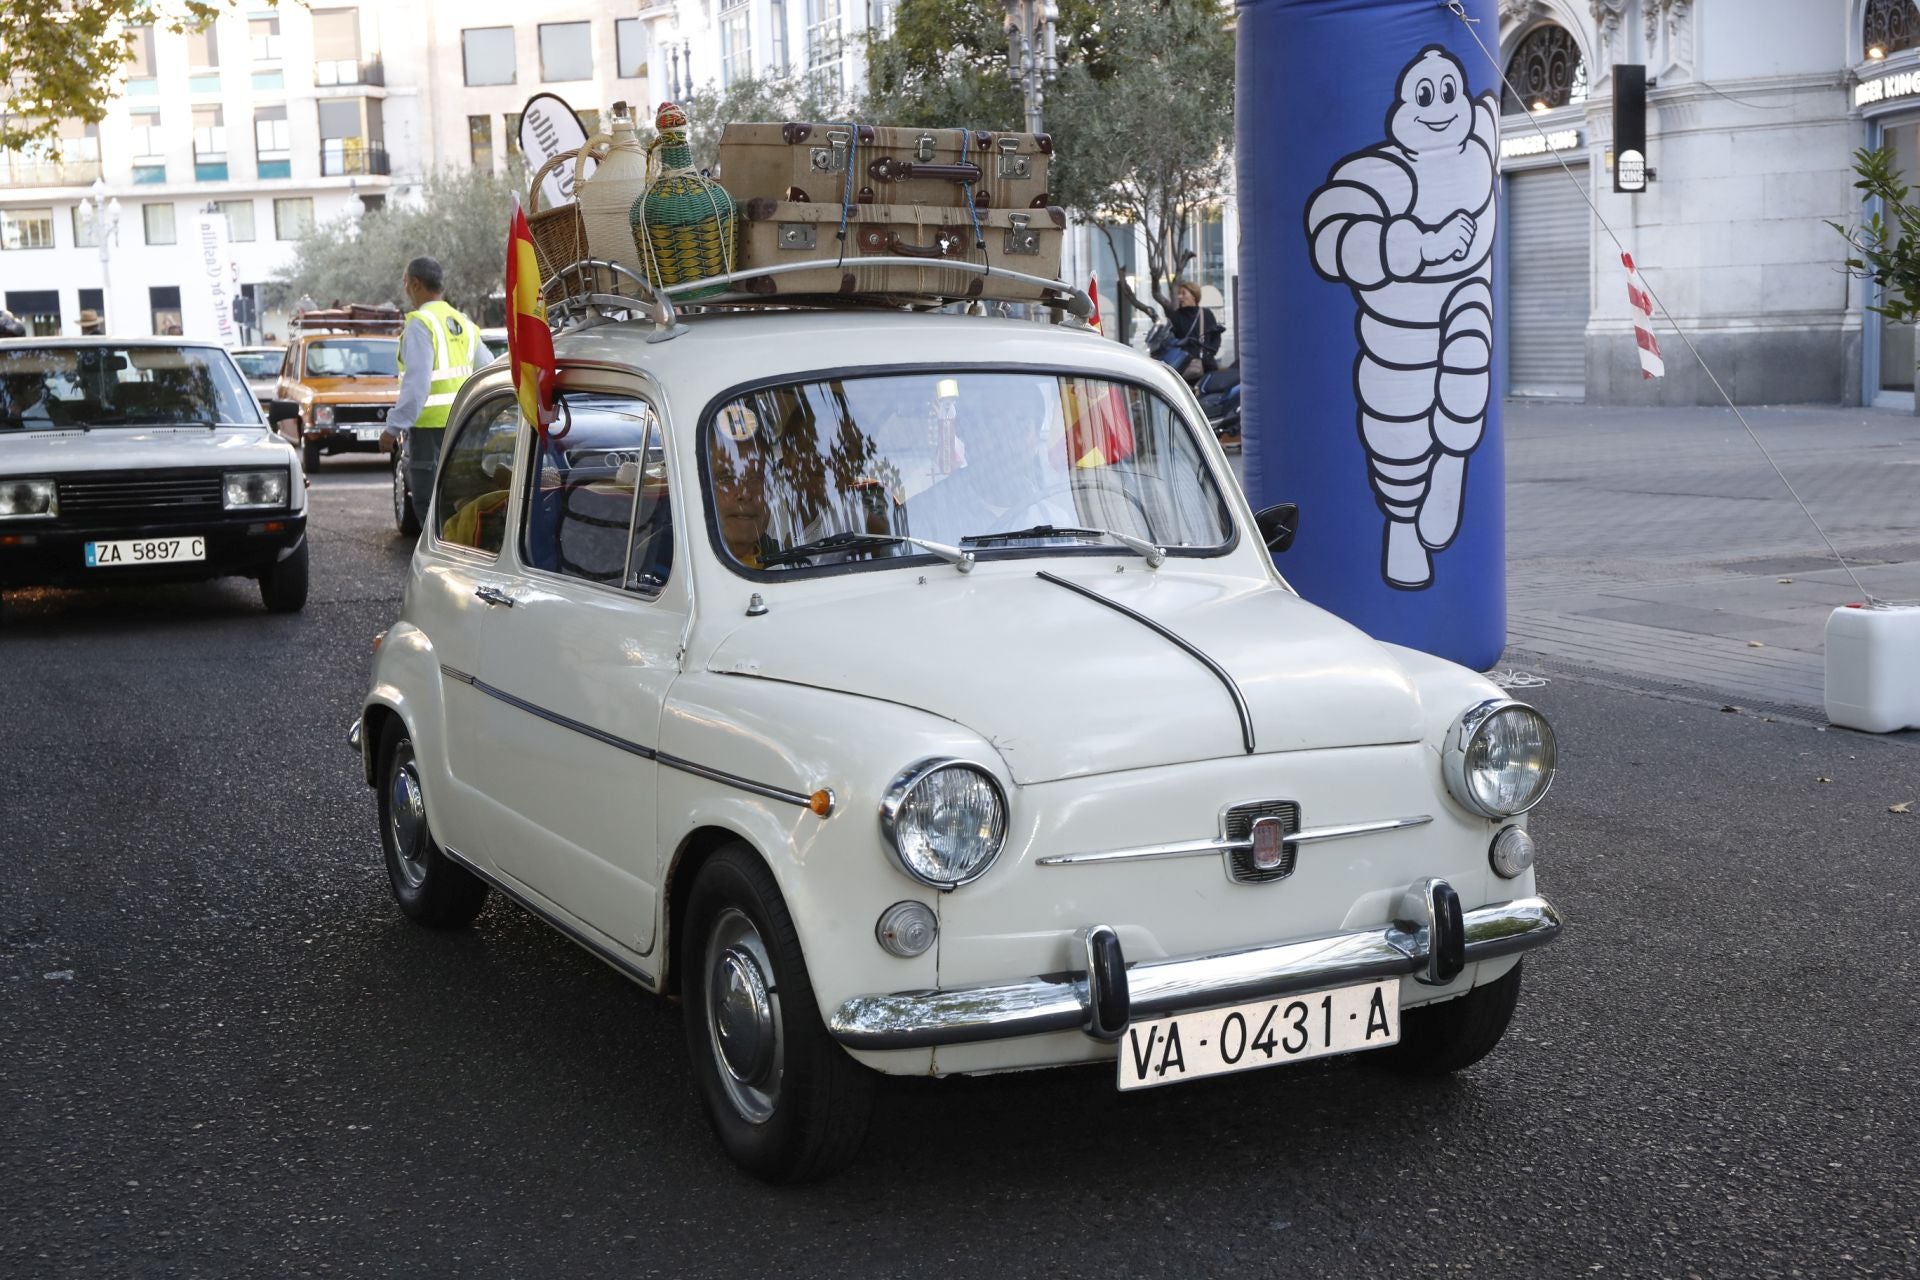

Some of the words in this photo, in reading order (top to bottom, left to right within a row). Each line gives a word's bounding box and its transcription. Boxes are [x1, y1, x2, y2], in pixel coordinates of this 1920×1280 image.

[1619, 162, 1644, 170] BURGER
[1619, 170, 1644, 182] KING
[97, 544, 122, 563] ZA
[132, 540, 181, 561] 5897
[191, 539, 203, 557] C
